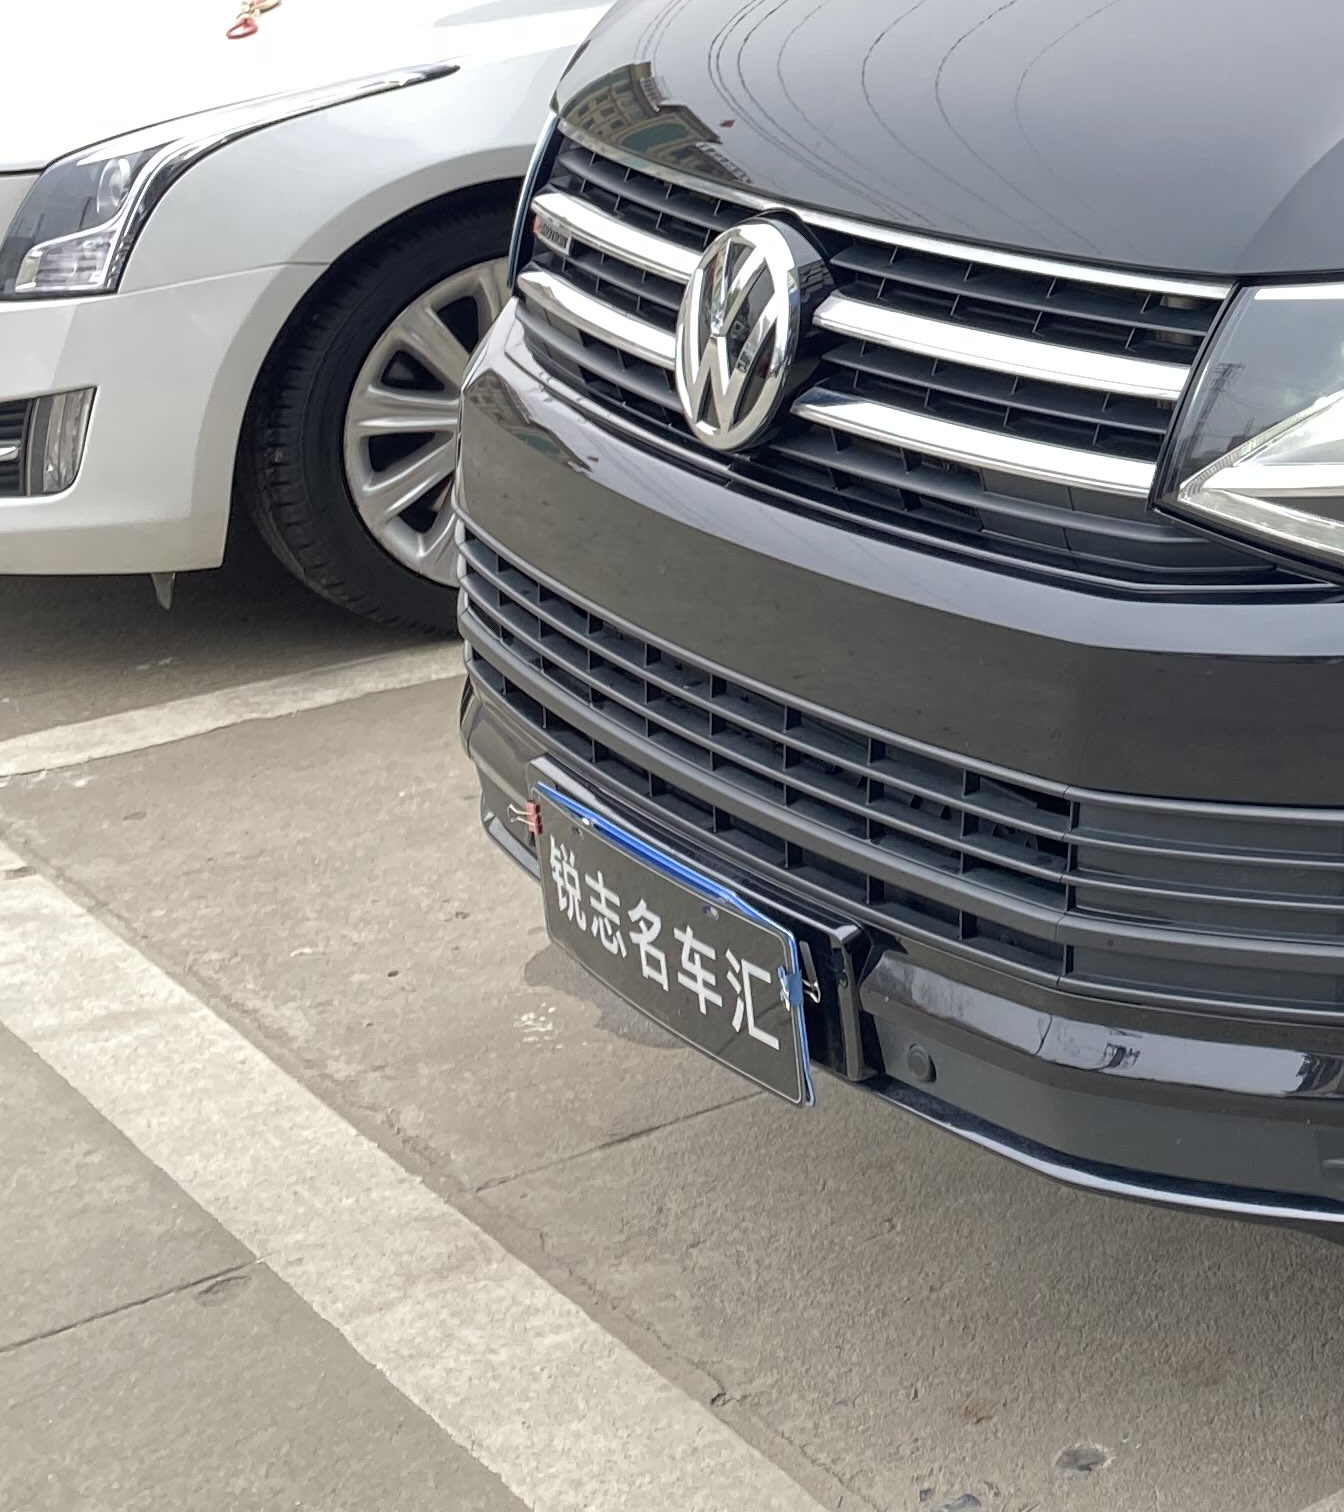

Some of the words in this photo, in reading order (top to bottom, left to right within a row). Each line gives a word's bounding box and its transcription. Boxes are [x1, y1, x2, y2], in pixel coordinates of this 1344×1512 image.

[548, 832, 781, 1051] 锐志名车汇
